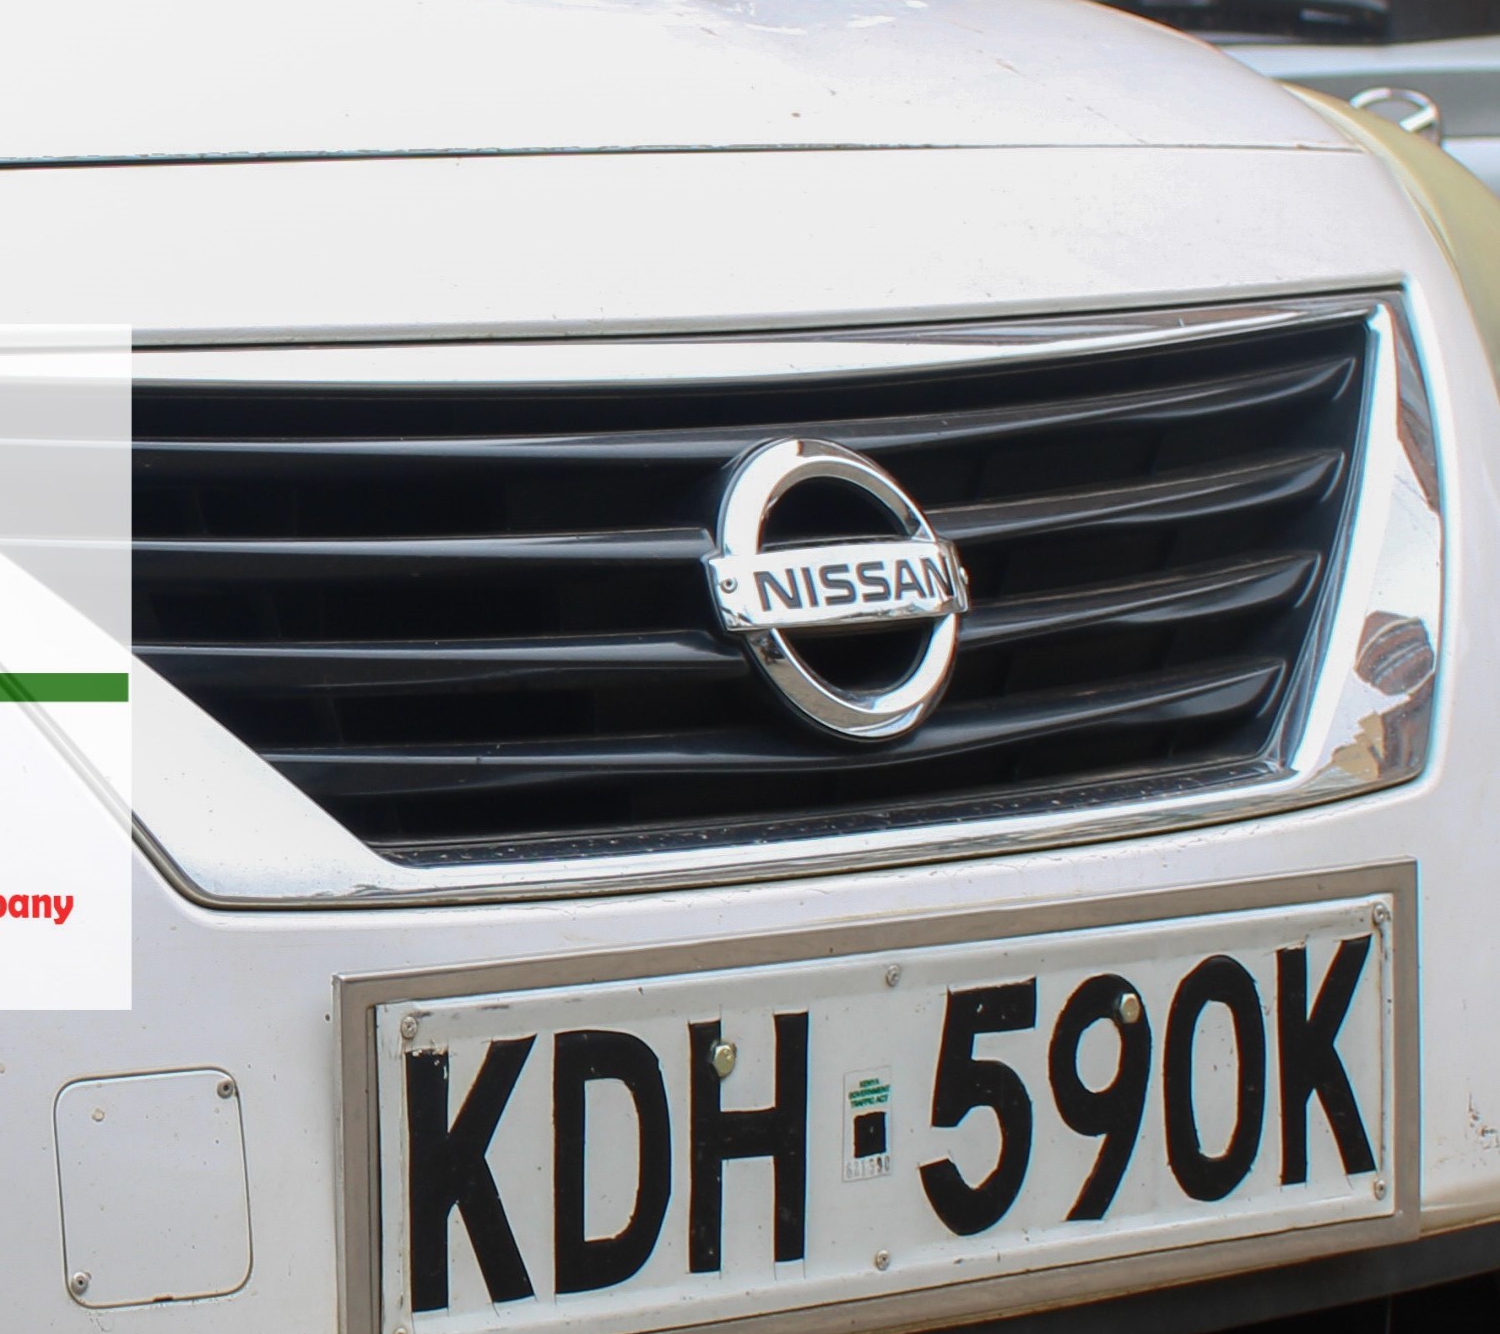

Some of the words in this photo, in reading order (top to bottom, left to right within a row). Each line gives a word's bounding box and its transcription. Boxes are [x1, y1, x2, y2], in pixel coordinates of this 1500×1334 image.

[753, 557, 954, 612] NISSAN
[404, 1011, 809, 1313] KDH
[918, 934, 1377, 1237] 590K
